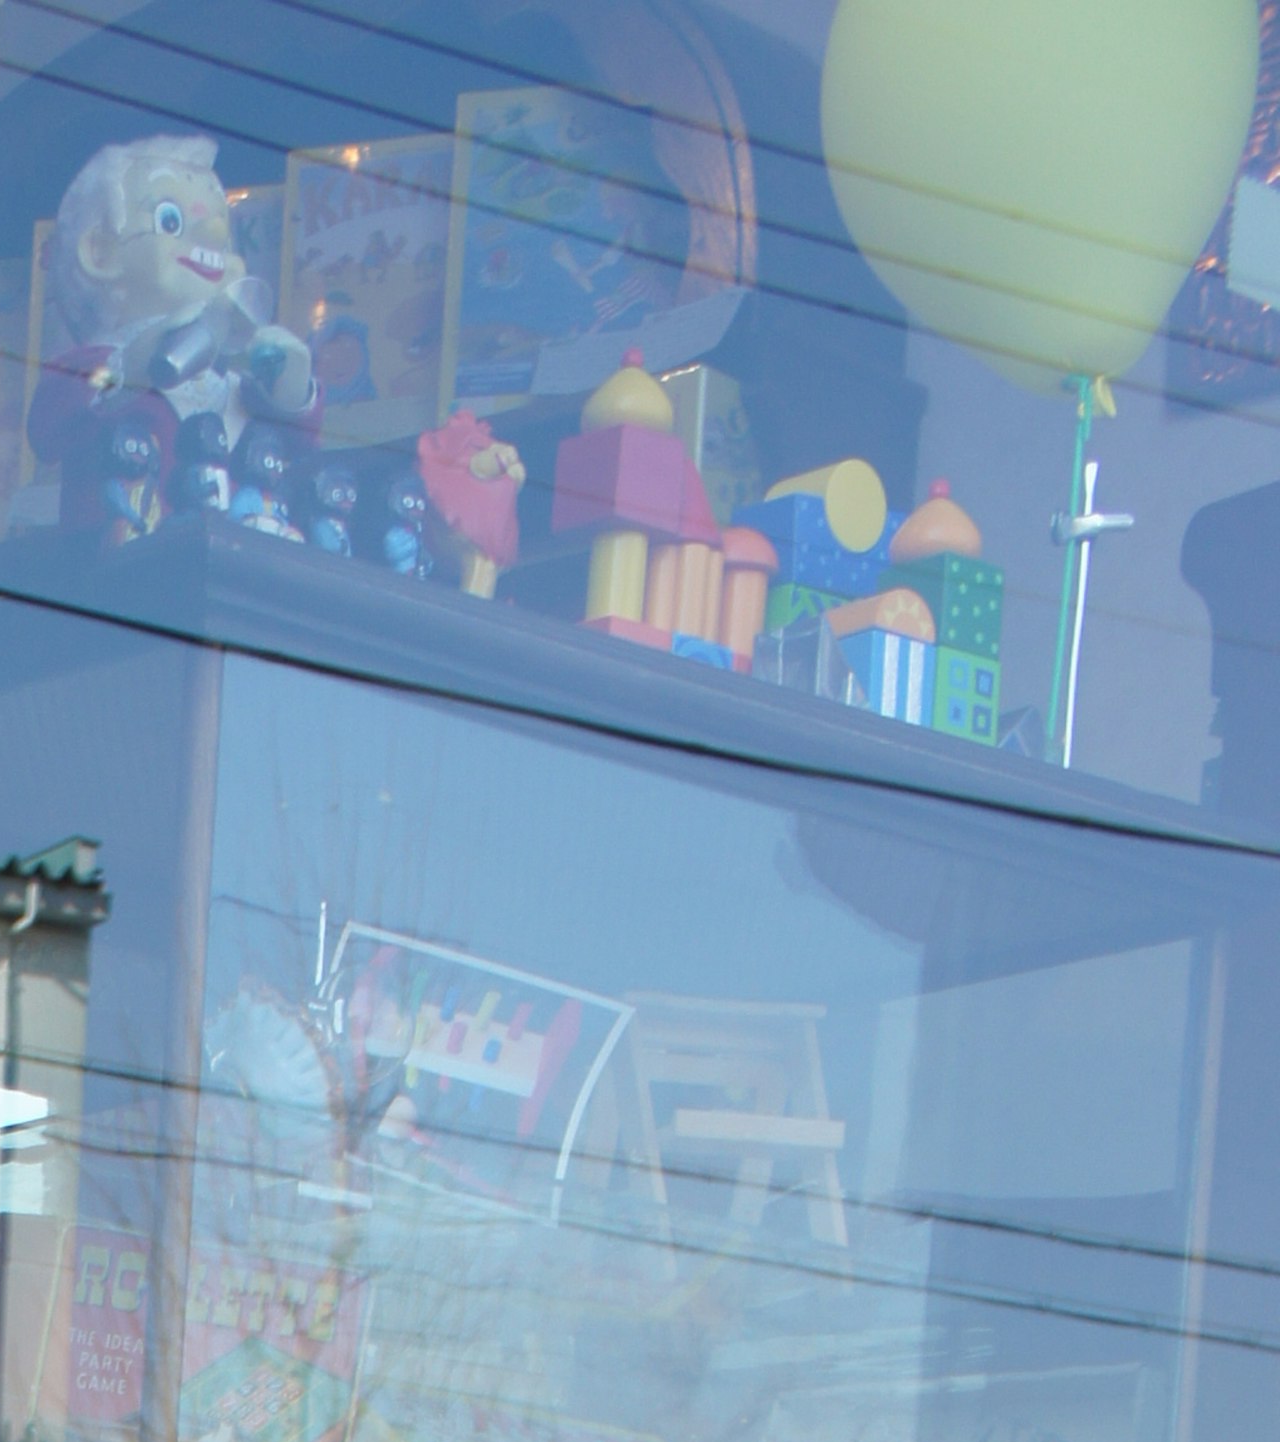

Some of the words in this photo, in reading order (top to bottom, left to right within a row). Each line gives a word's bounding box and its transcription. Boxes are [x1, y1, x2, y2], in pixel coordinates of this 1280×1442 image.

[73, 1245, 339, 1342] ROLETTE
[69, 1327, 96, 1346] THE
[79, 1350, 135, 1374] PARTY
[76, 1372, 128, 1395] GAME
